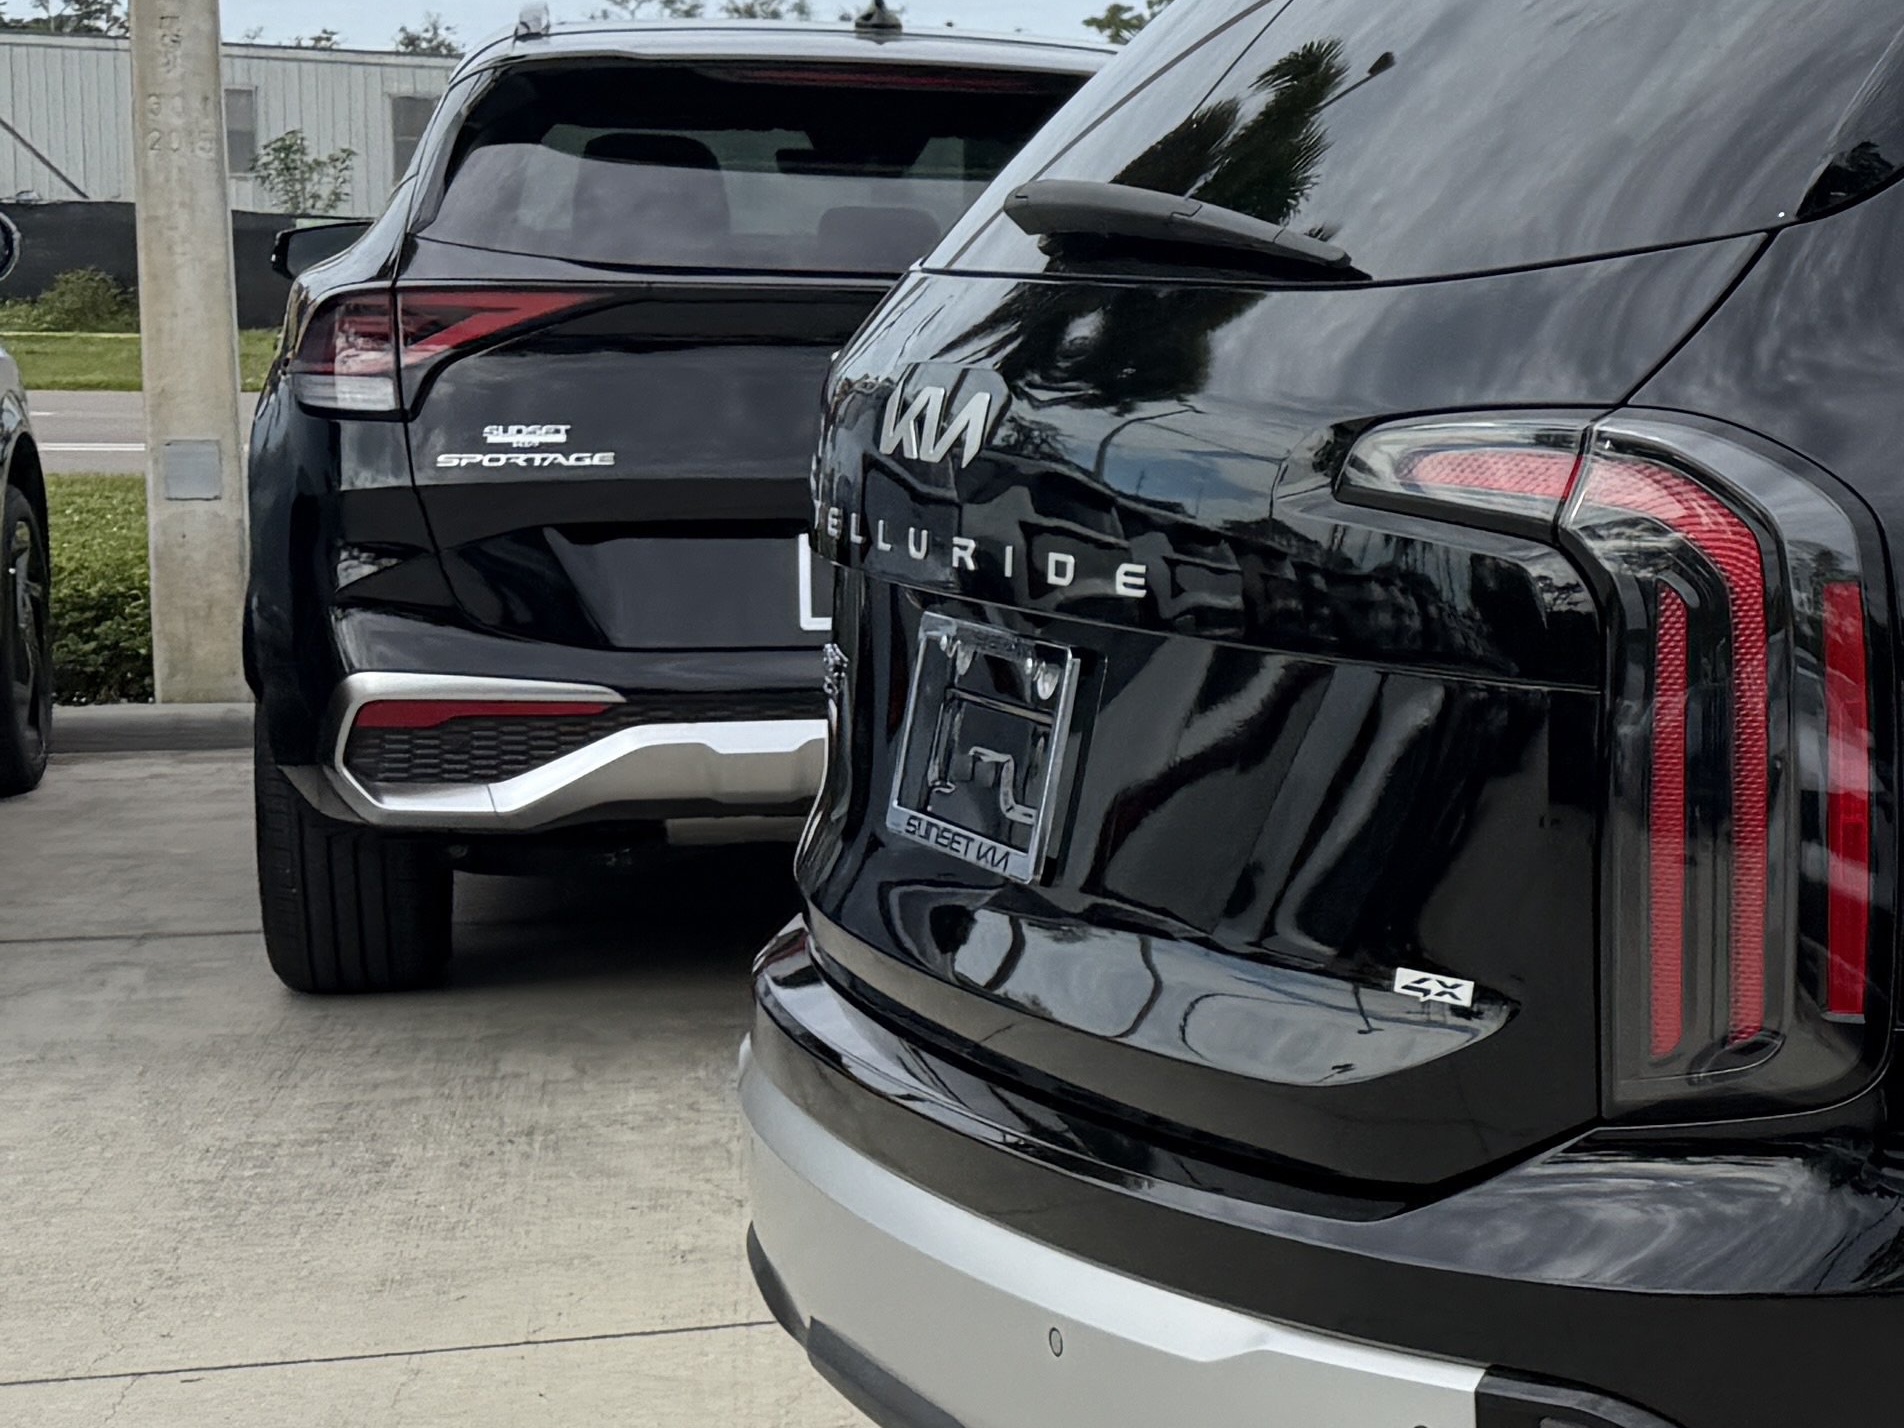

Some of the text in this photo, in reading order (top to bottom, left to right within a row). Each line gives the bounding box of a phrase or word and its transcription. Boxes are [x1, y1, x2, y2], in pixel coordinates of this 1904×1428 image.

[878, 385, 992, 469] KIA
[436, 452, 616, 468] SPORTAGE
[904, 814, 976, 858] SUNSET
